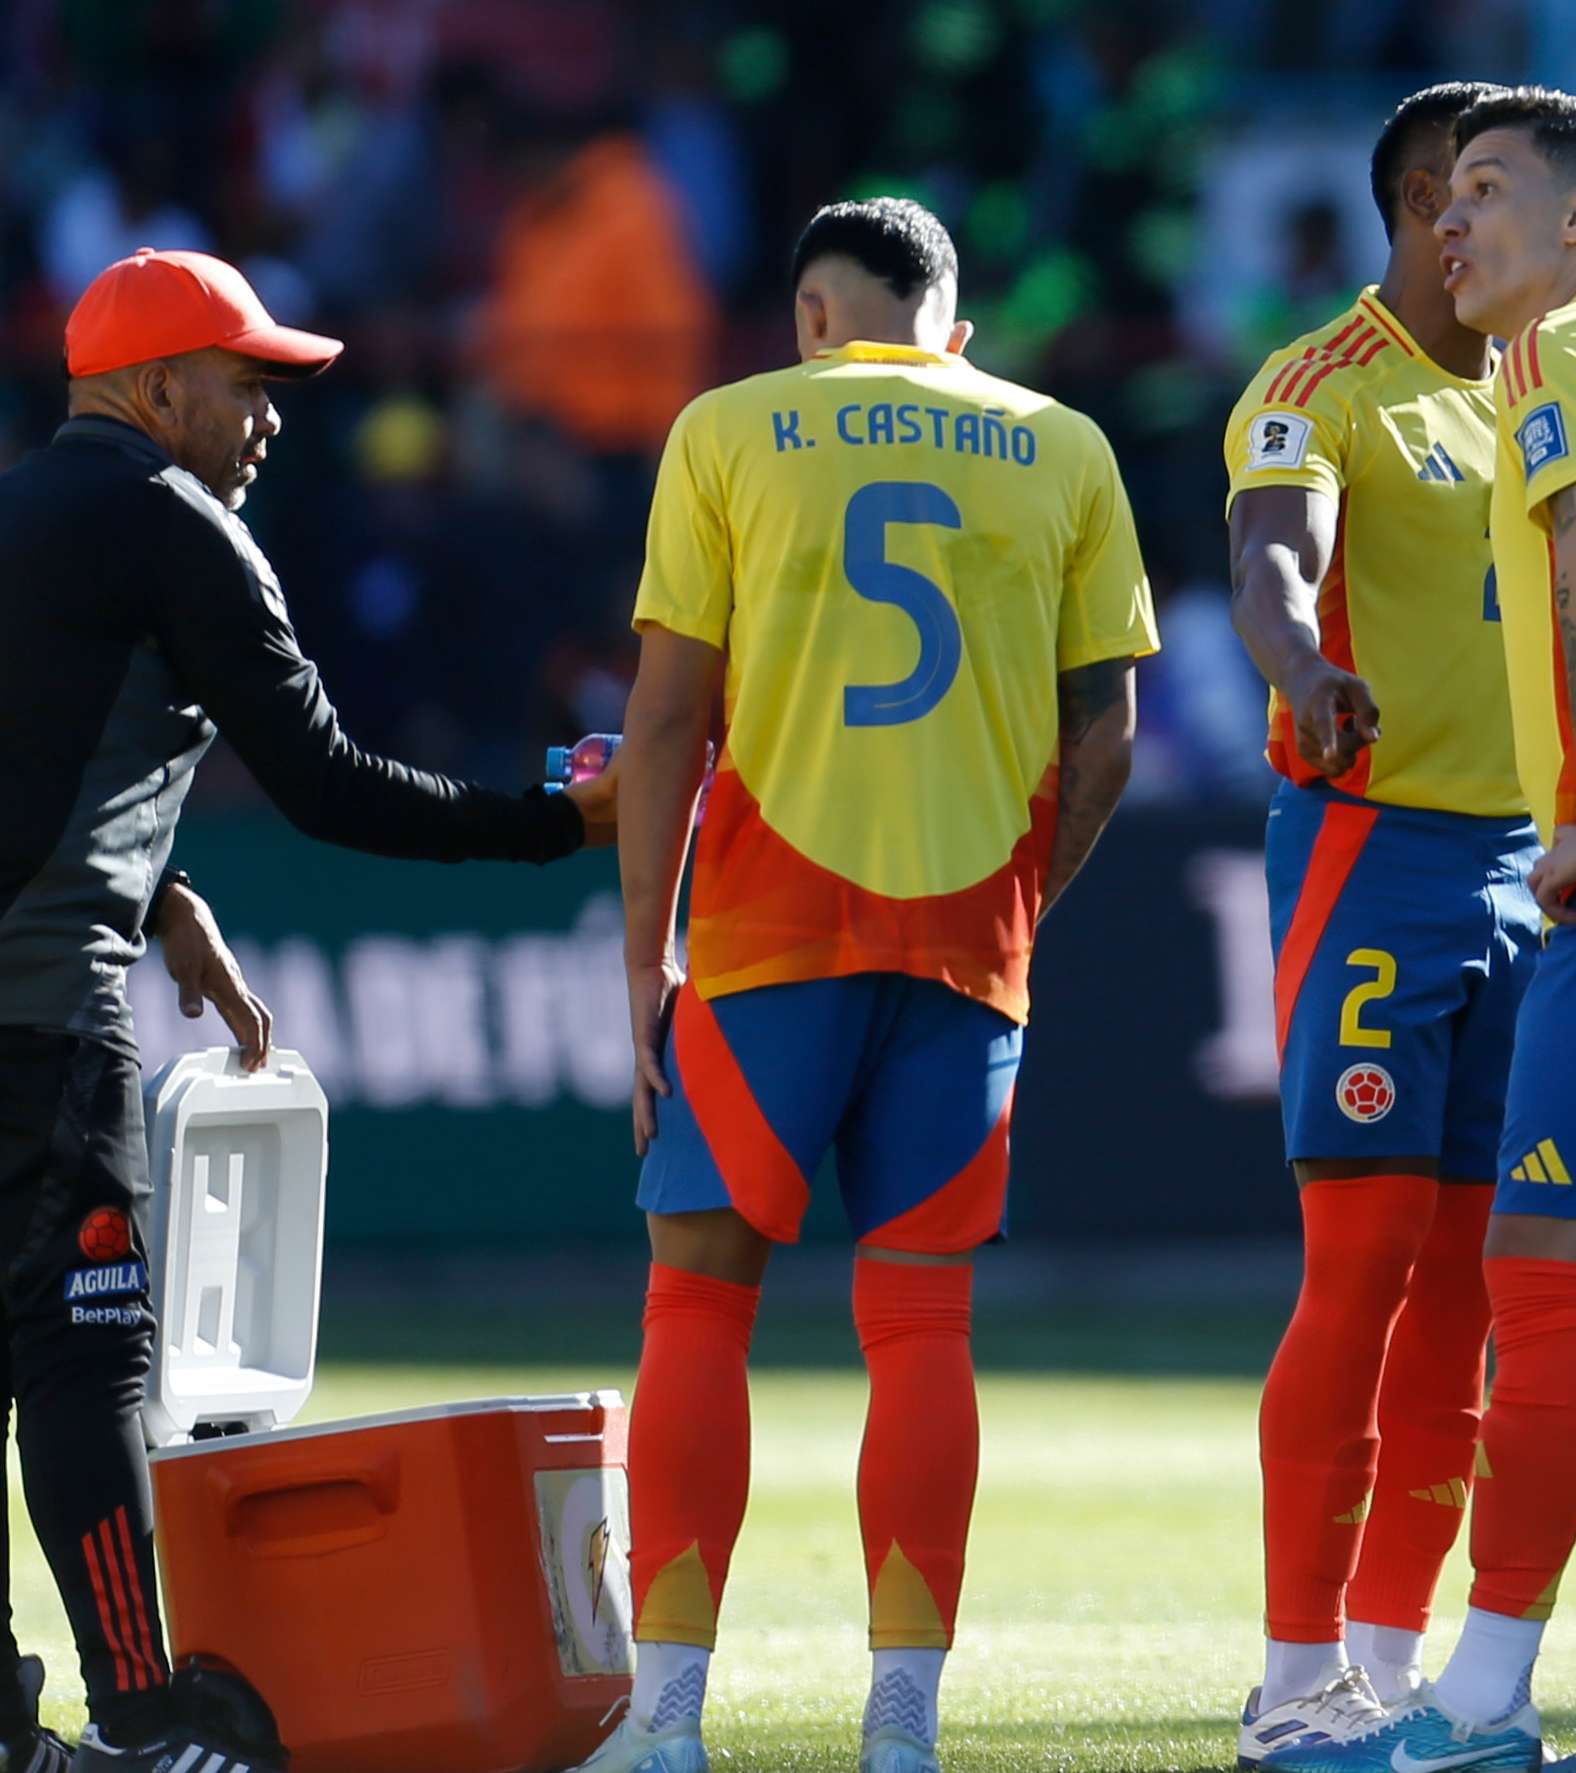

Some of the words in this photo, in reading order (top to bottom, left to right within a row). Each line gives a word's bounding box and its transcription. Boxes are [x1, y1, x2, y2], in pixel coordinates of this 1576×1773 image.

[772, 410, 817, 453] K.
[836, 402, 1037, 467] CASTAÑO
[843, 480, 963, 727] 5
[1338, 947, 1397, 1049] 2
[68, 1264, 140, 1298] AGUILA
[71, 1306, 141, 1326] BetPlay
